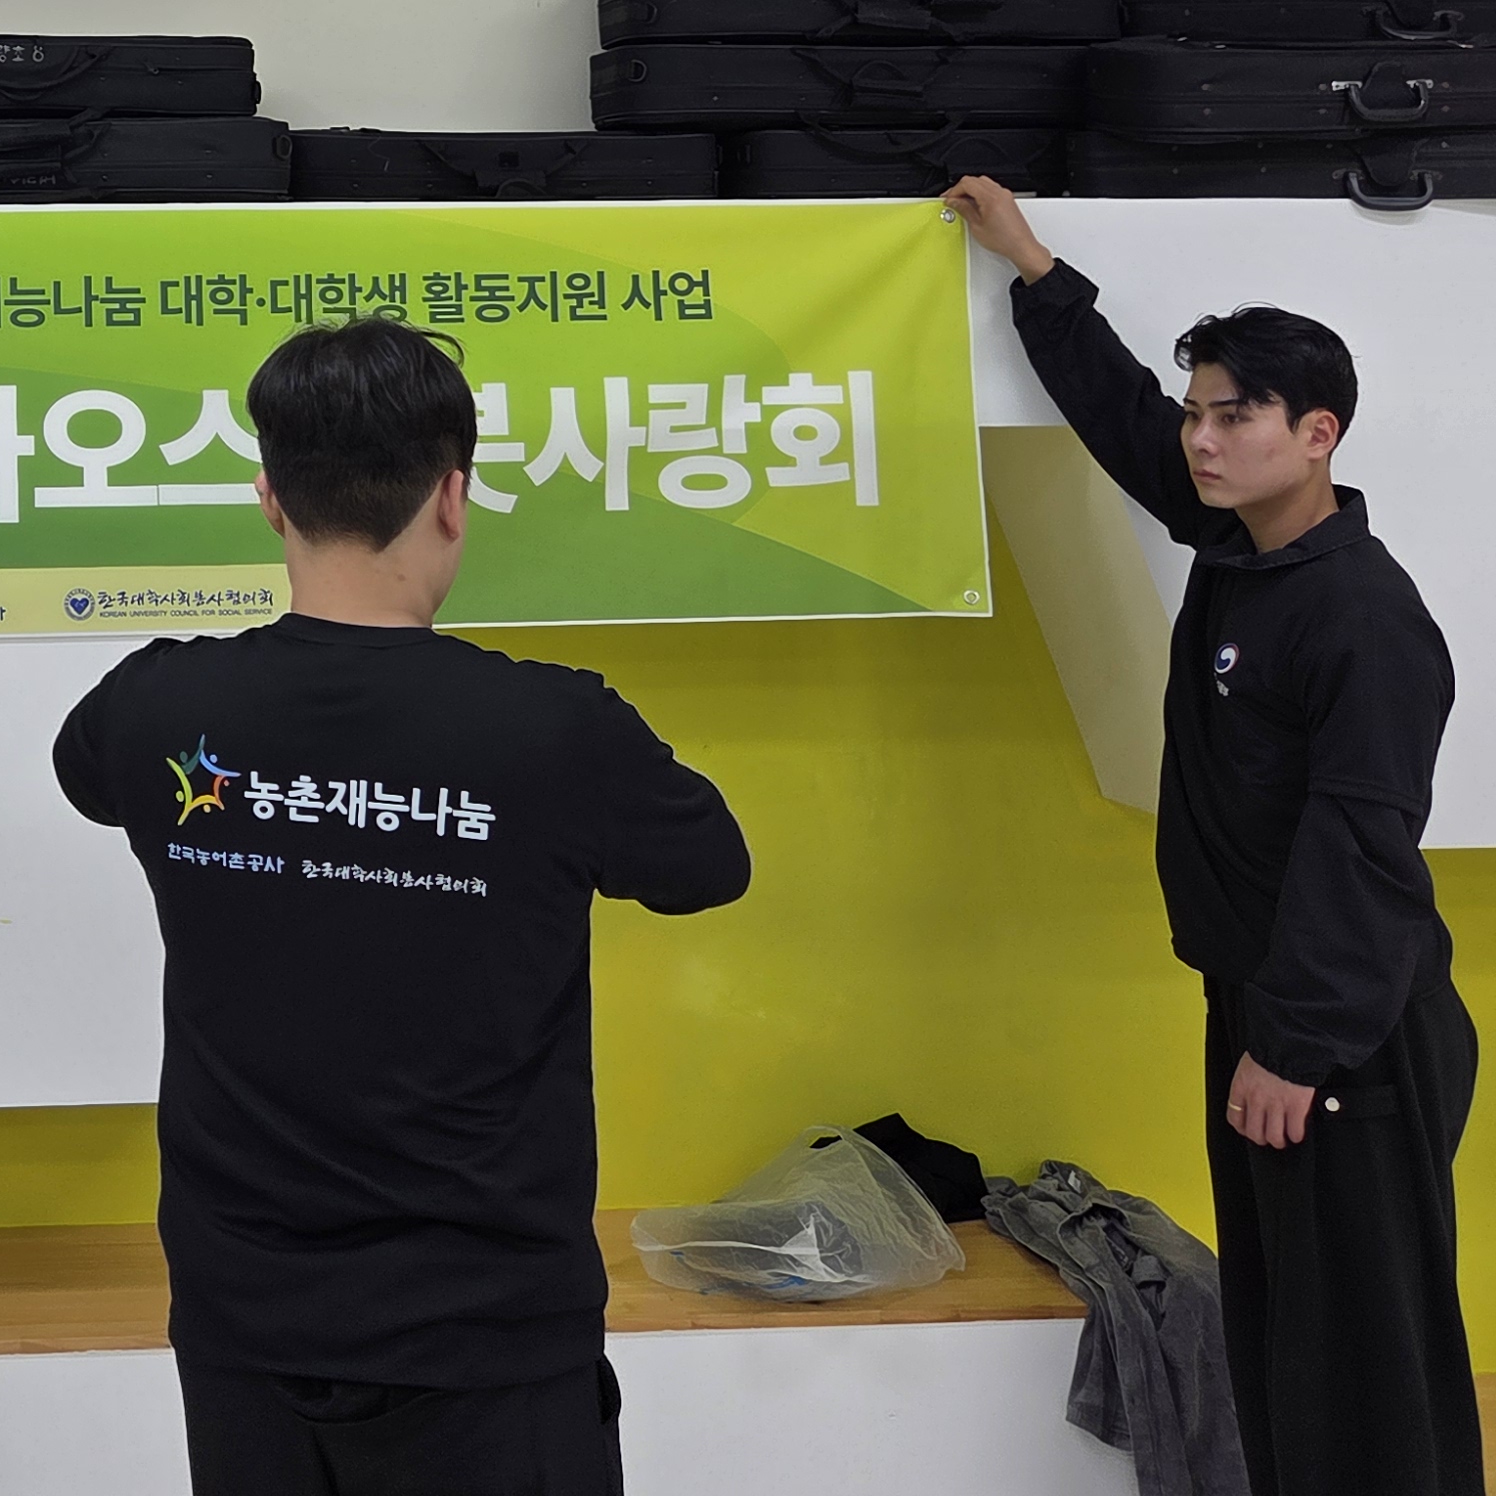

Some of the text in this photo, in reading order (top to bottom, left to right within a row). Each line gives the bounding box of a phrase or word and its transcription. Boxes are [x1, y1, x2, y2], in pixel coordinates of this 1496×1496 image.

[32, 45, 45, 63] 8
[160, 272, 408, 326] 대학·대학생
[421, 270, 608, 323] 활동지원
[620, 269, 713, 321] 사업
[97, 588, 274, 608] 한국대학사회봉사협의회
[99, 610, 127, 618] KOREAN
[129, 610, 167, 618] UNIVERSITY
[170, 609, 198, 617] COUNCIL
[218, 608, 242, 616] SOCIAL
[244, 770, 496, 841] 농촌재능나눔
[167, 842, 488, 898] 한국농어촌공사 한국대학사회봉사협의회
